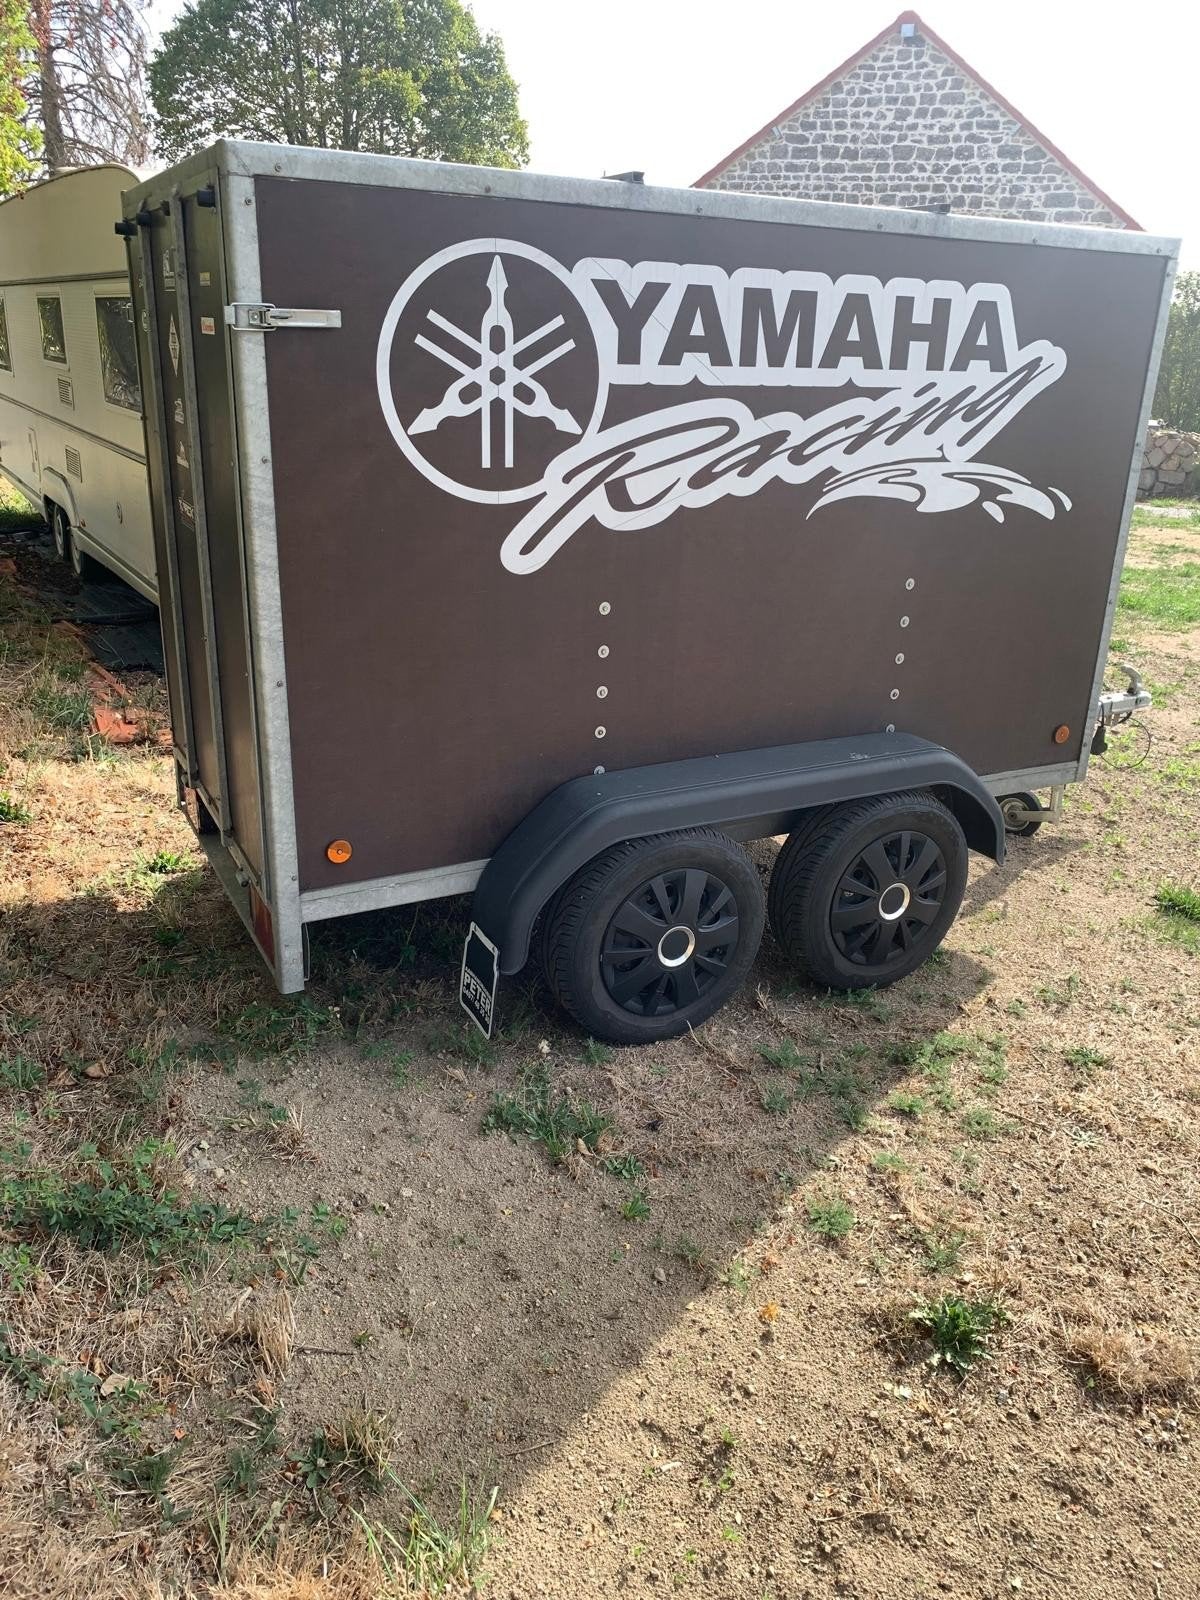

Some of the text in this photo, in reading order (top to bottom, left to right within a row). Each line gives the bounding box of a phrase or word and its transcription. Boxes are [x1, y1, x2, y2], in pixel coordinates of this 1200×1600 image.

[592, 278, 1008, 373] YAMAHA
[517, 354, 1055, 557] Racing
[463, 972, 491, 1015] PETER
